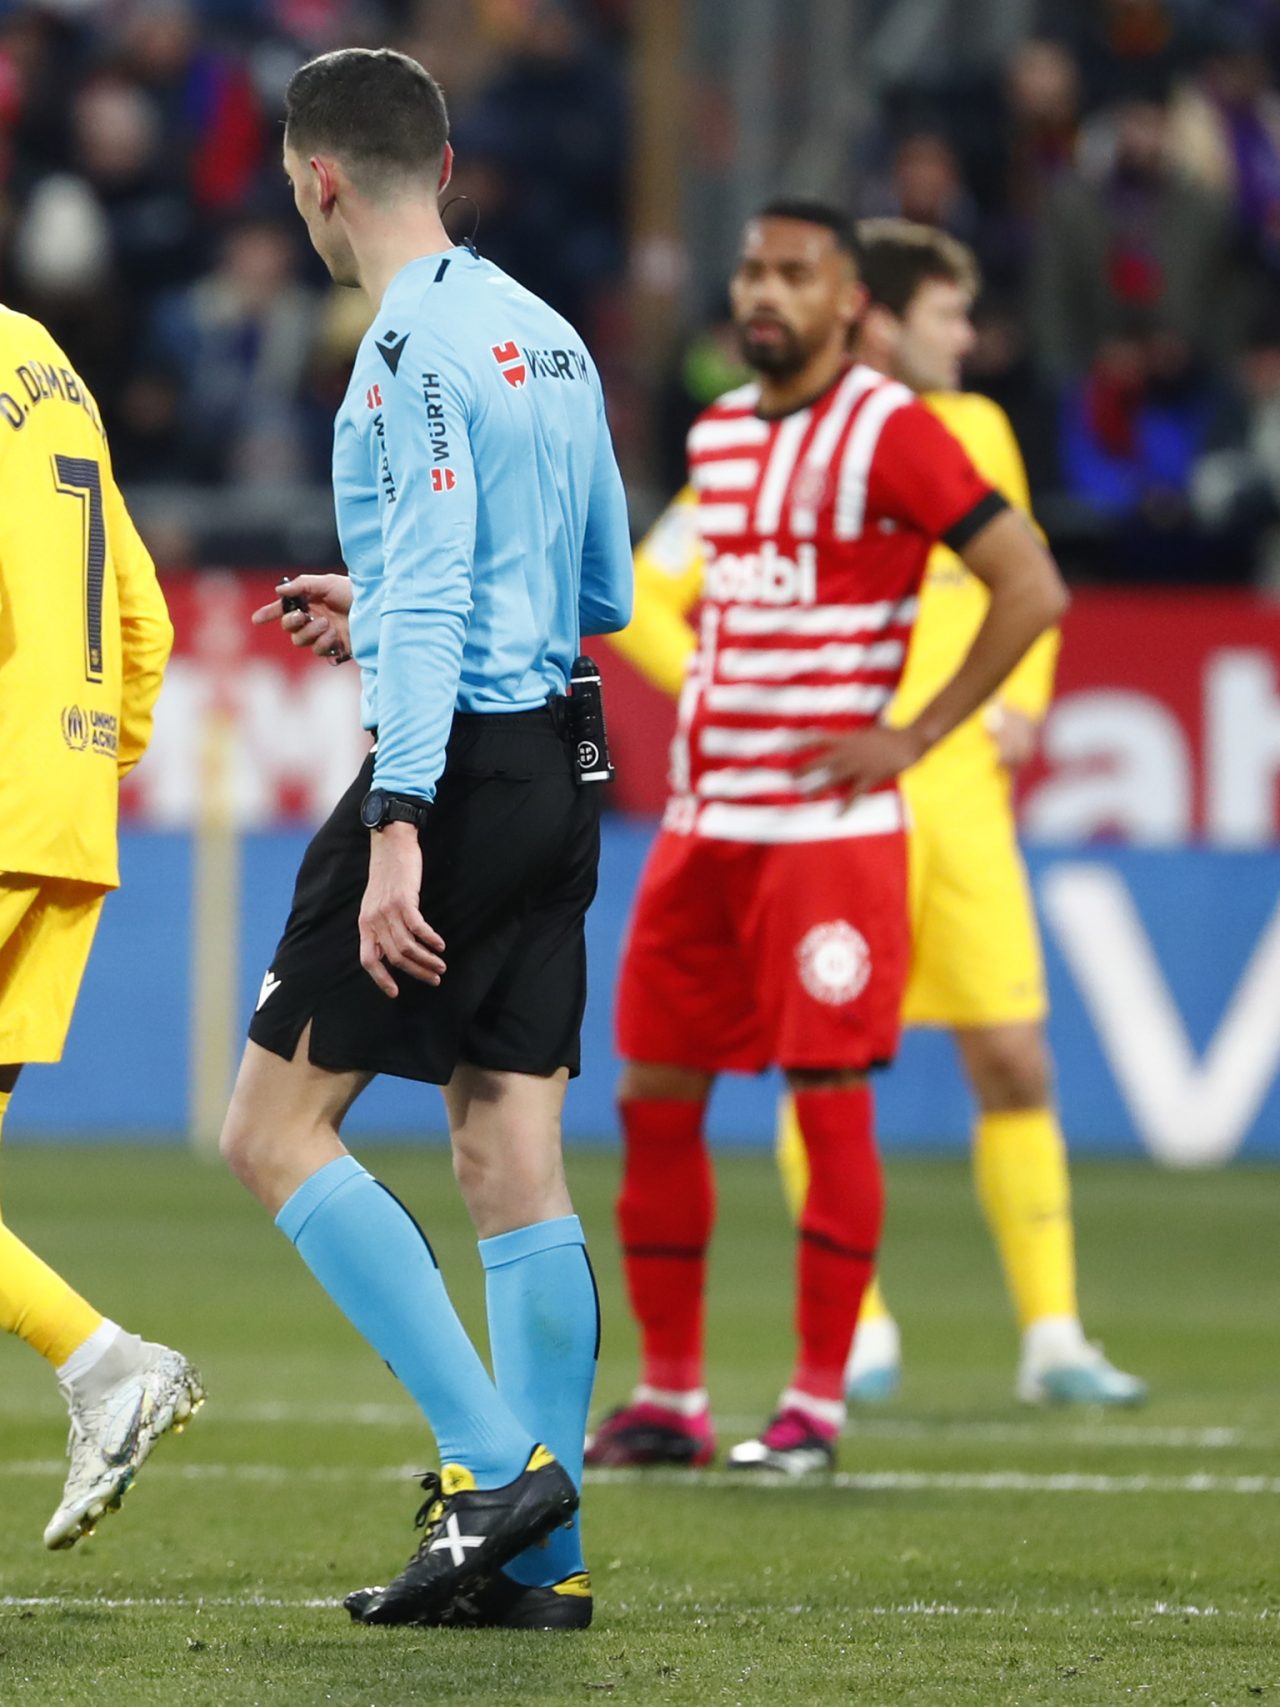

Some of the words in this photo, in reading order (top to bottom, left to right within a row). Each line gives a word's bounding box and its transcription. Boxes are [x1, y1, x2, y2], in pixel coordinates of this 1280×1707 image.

[522, 346, 590, 385] WÜRTH
[422, 373, 450, 462] WÜRTH
[49, 452, 105, 684] 7
[696, 538, 817, 606] osbi
